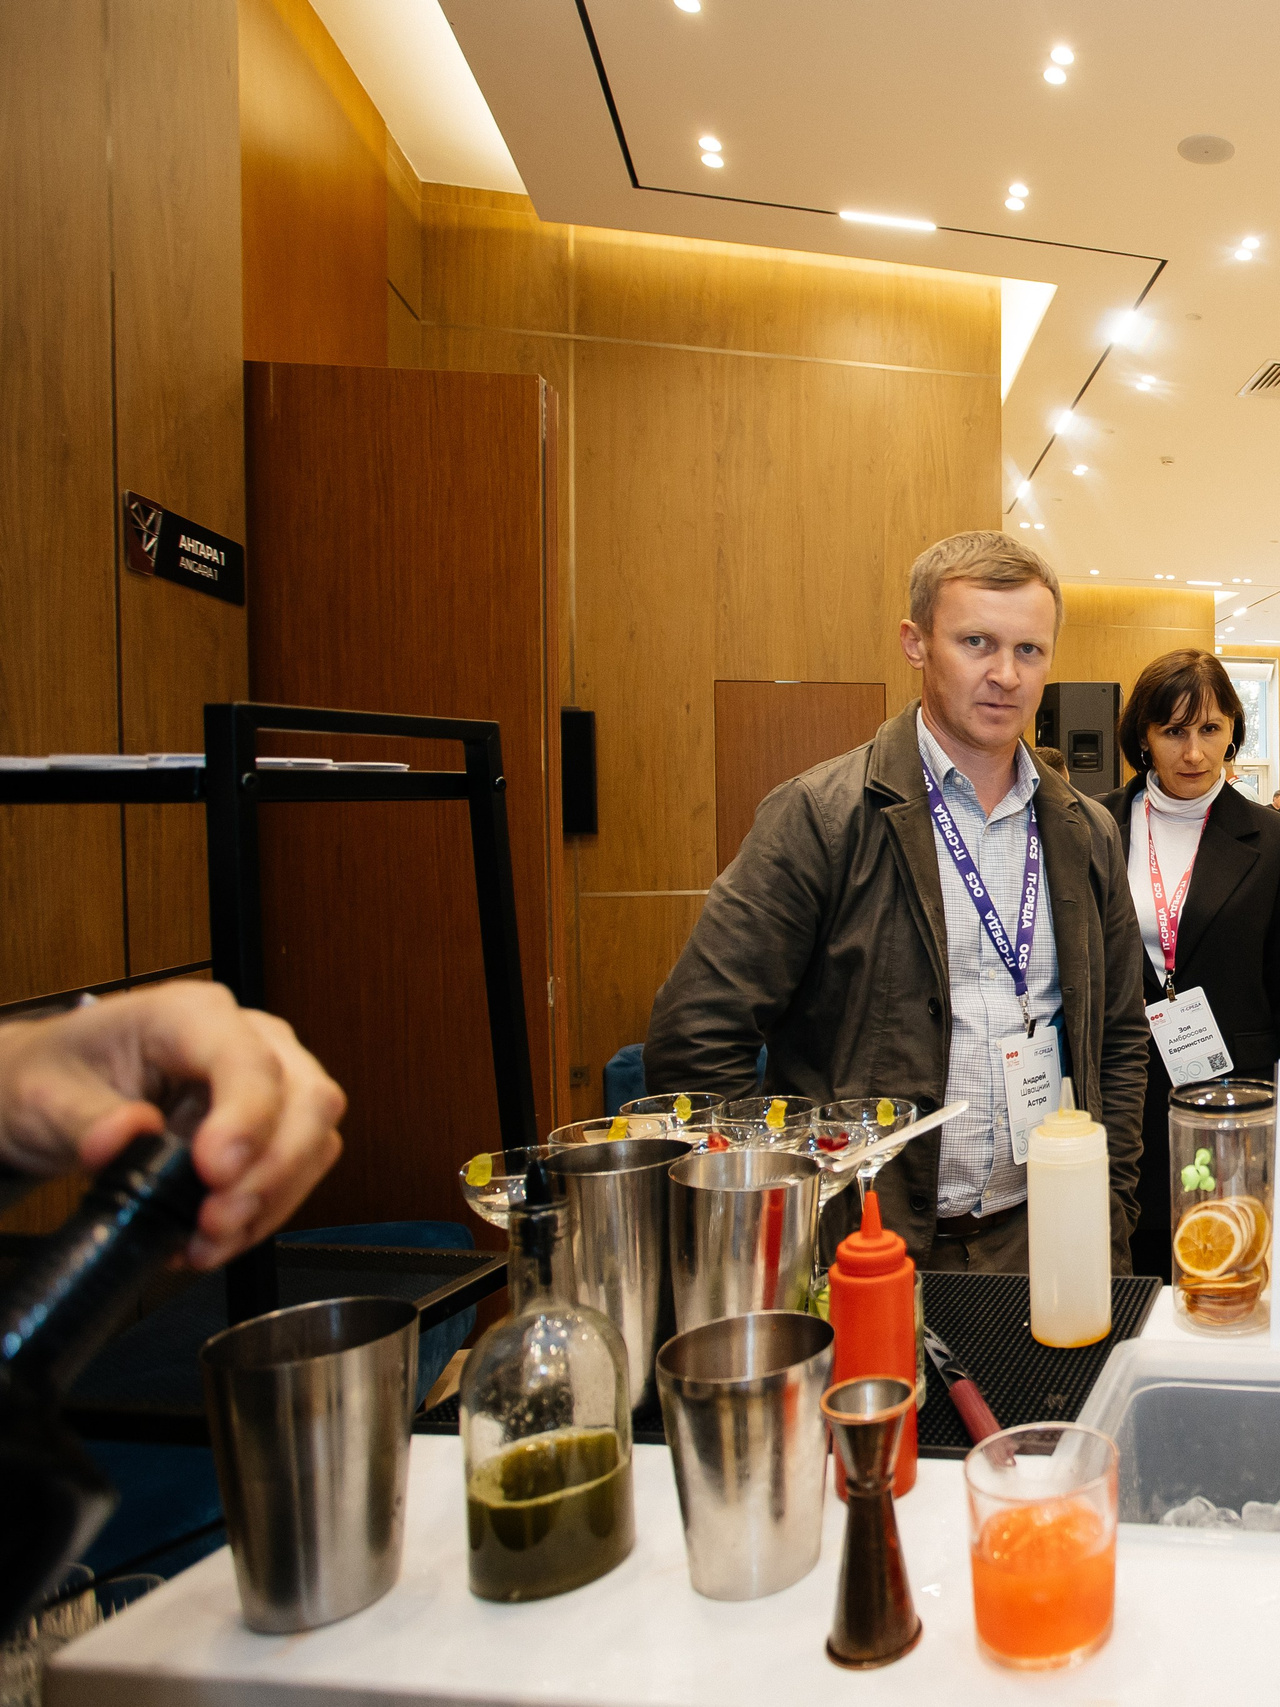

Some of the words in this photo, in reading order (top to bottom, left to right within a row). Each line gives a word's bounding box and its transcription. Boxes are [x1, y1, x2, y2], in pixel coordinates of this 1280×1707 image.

[179, 534, 220, 564] АНГАРА
[219, 551, 226, 566] 1
[933, 803, 967, 861] IT-СРЕДА
[1029, 835, 1038, 860] OCS
[965, 871, 984, 898] OCS
[1154, 882, 1163, 899] OCS
[1021, 872, 1038, 929] IT-СРЕДА
[984, 909, 1016, 968] IT-СРЕДА
[1158, 907, 1171, 951] IT-СРЕДА
[1018, 943, 1030, 970] OCS
[1178, 1025, 1192, 1034] Зоя
[1168, 1034, 1214, 1055] Евроинсталл
[1022, 1071, 1047, 1086] Андрей
[1027, 1097, 1047, 1109] Астра
[1016, 1129, 1029, 1156] 3
